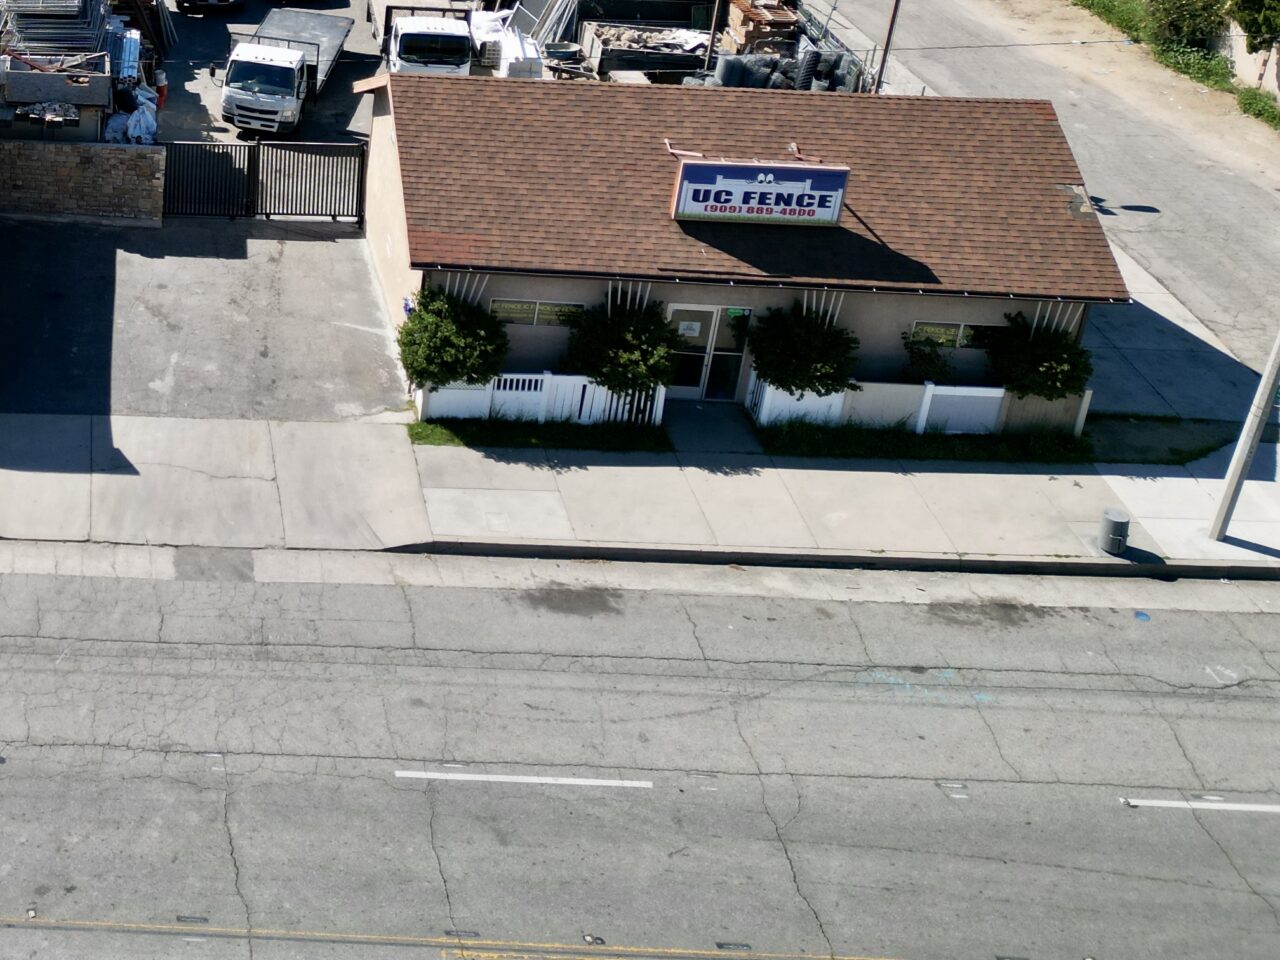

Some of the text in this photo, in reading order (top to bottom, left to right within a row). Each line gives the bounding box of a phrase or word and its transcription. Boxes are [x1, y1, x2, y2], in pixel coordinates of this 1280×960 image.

[692, 189, 833, 208] UC FENCE
[704, 204, 816, 217] (909) 889-4800
